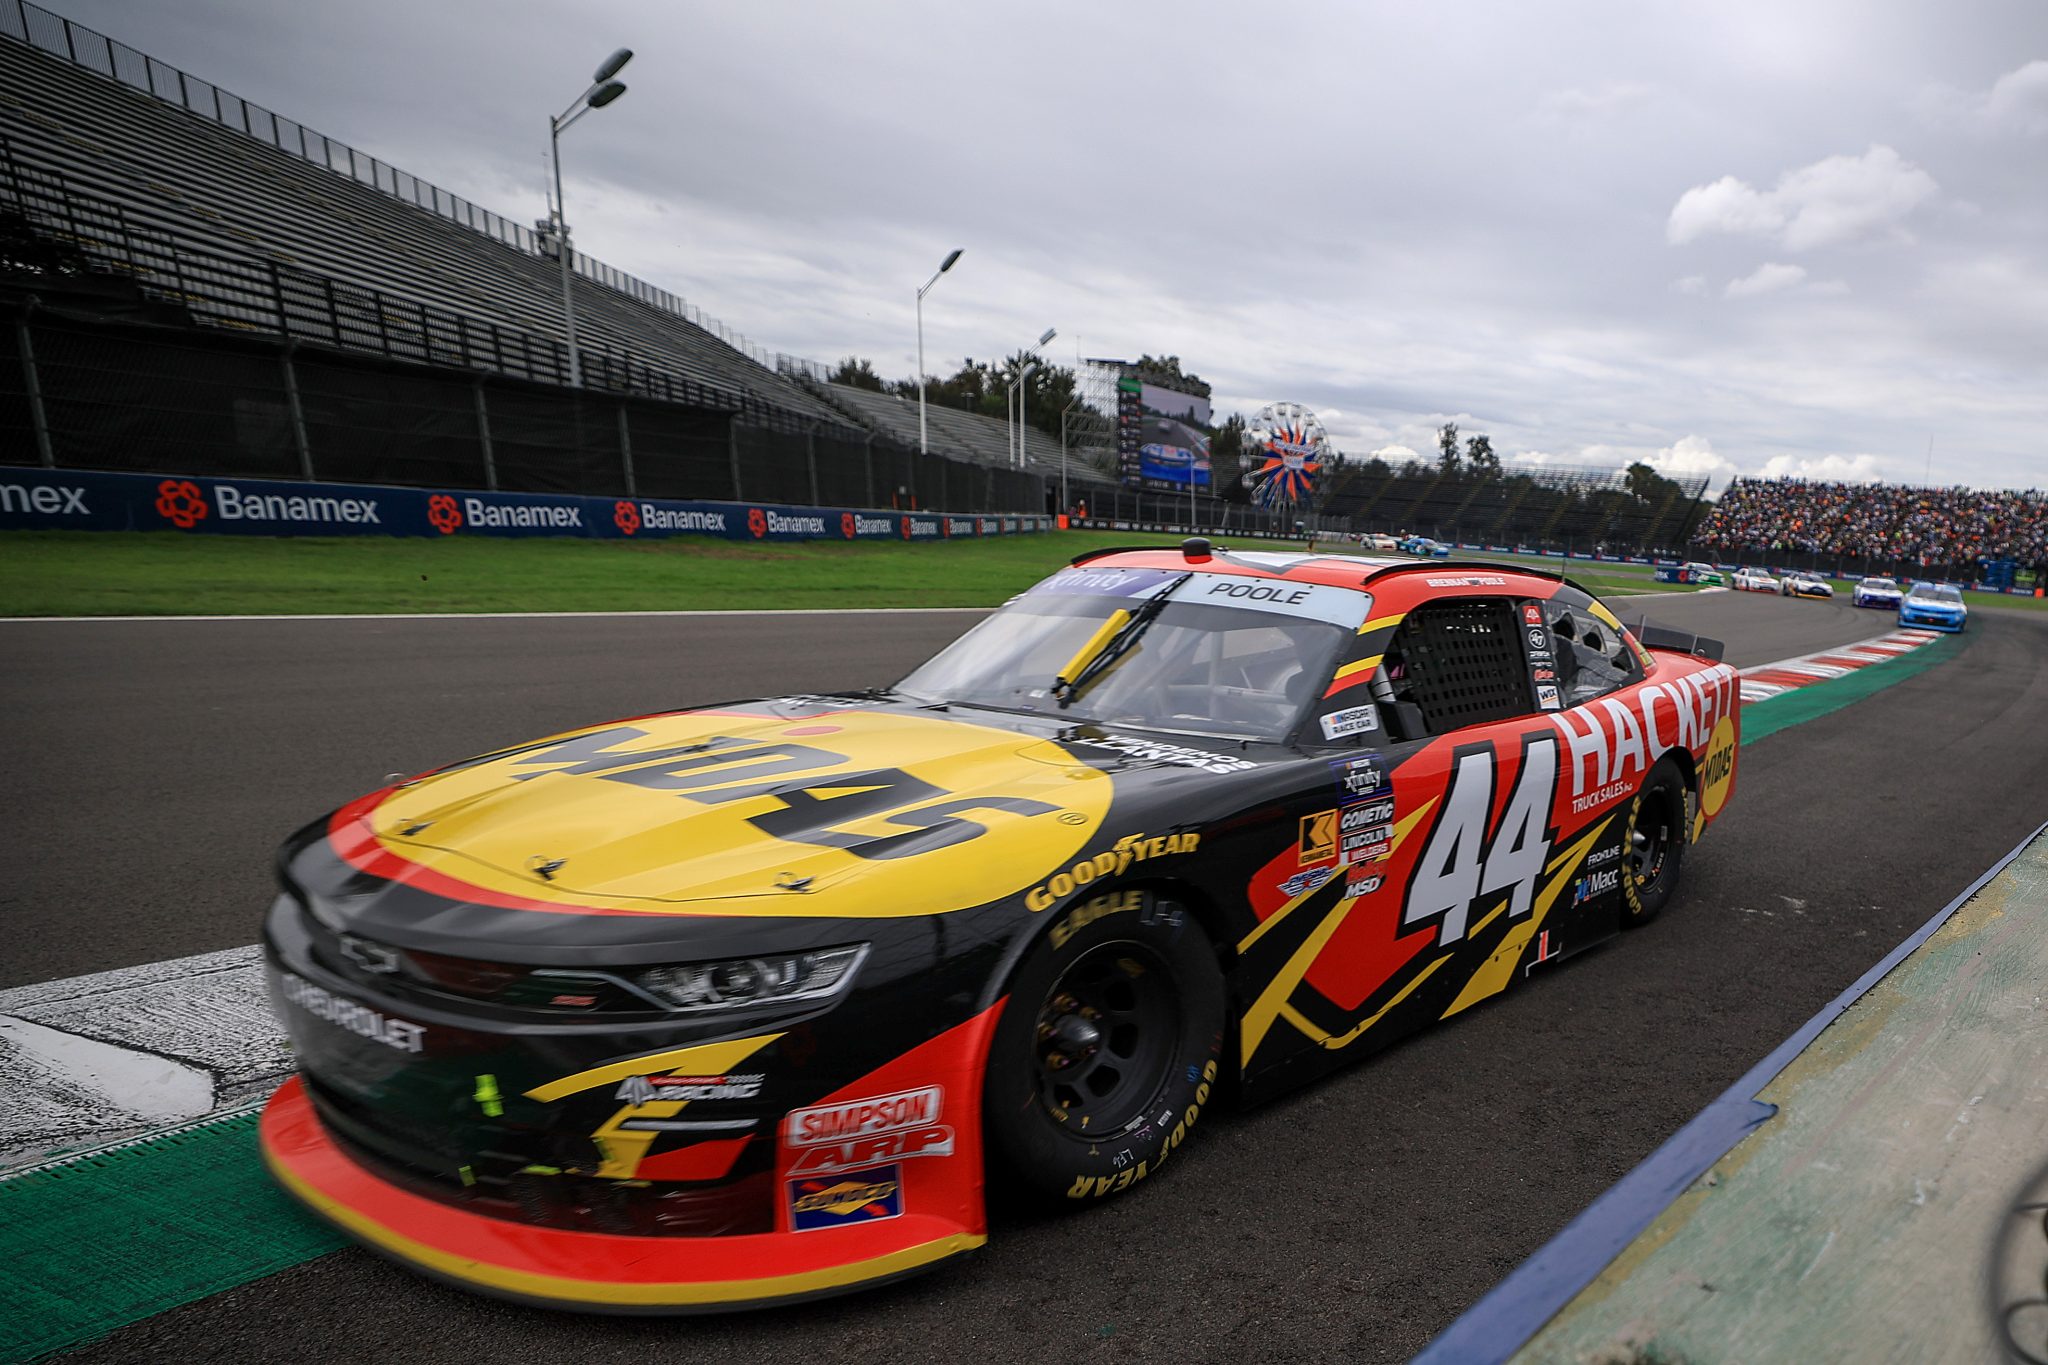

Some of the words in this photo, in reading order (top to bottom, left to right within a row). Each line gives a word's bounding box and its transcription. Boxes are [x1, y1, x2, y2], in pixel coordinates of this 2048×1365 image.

[213, 485, 381, 524] Banamex
[465, 498, 582, 528] Banamex
[641, 503, 726, 532] Banamex
[767, 510, 826, 534] Banamex
[854, 514, 893, 534] Banamex
[1207, 583, 1311, 605] POOLE
[1540, 687, 1557, 699] WIX
[1332, 722, 1355, 734] RACE
[1356, 719, 1371, 730] CAR
[1548, 664, 1733, 797] HACKETT
[1072, 738, 1231, 774] LLANTAS
[1103, 735, 1257, 770] VENDEMOS
[1705, 743, 1734, 790] MIDAS
[507, 726, 1063, 861] MIDAS
[1344, 769, 1380, 793] xfinity
[1572, 795, 1600, 814] TRUCK
[1600, 781, 1625, 802] SALES
[1341, 803, 1394, 829] COMETIC
[1342, 827, 1385, 851] LINCOLN
[1351, 843, 1388, 861] WELDERS
[1404, 738, 1551, 948] 44
[1587, 845, 1620, 866] FRONTLINE
[1025, 832, 1200, 913] GOODYEAR
[1590, 869, 1618, 893] Macc
[1344, 877, 1381, 899] MSD
[1050, 890, 1143, 951] EAGLE
[659, 1082, 762, 1101] RACING
[800, 1093, 931, 1142] SIMPSON
[1066, 1059, 1218, 1199] GOODYEAR
[786, 1124, 955, 1177] ARP
[794, 1181, 897, 1212] SUNOCO
